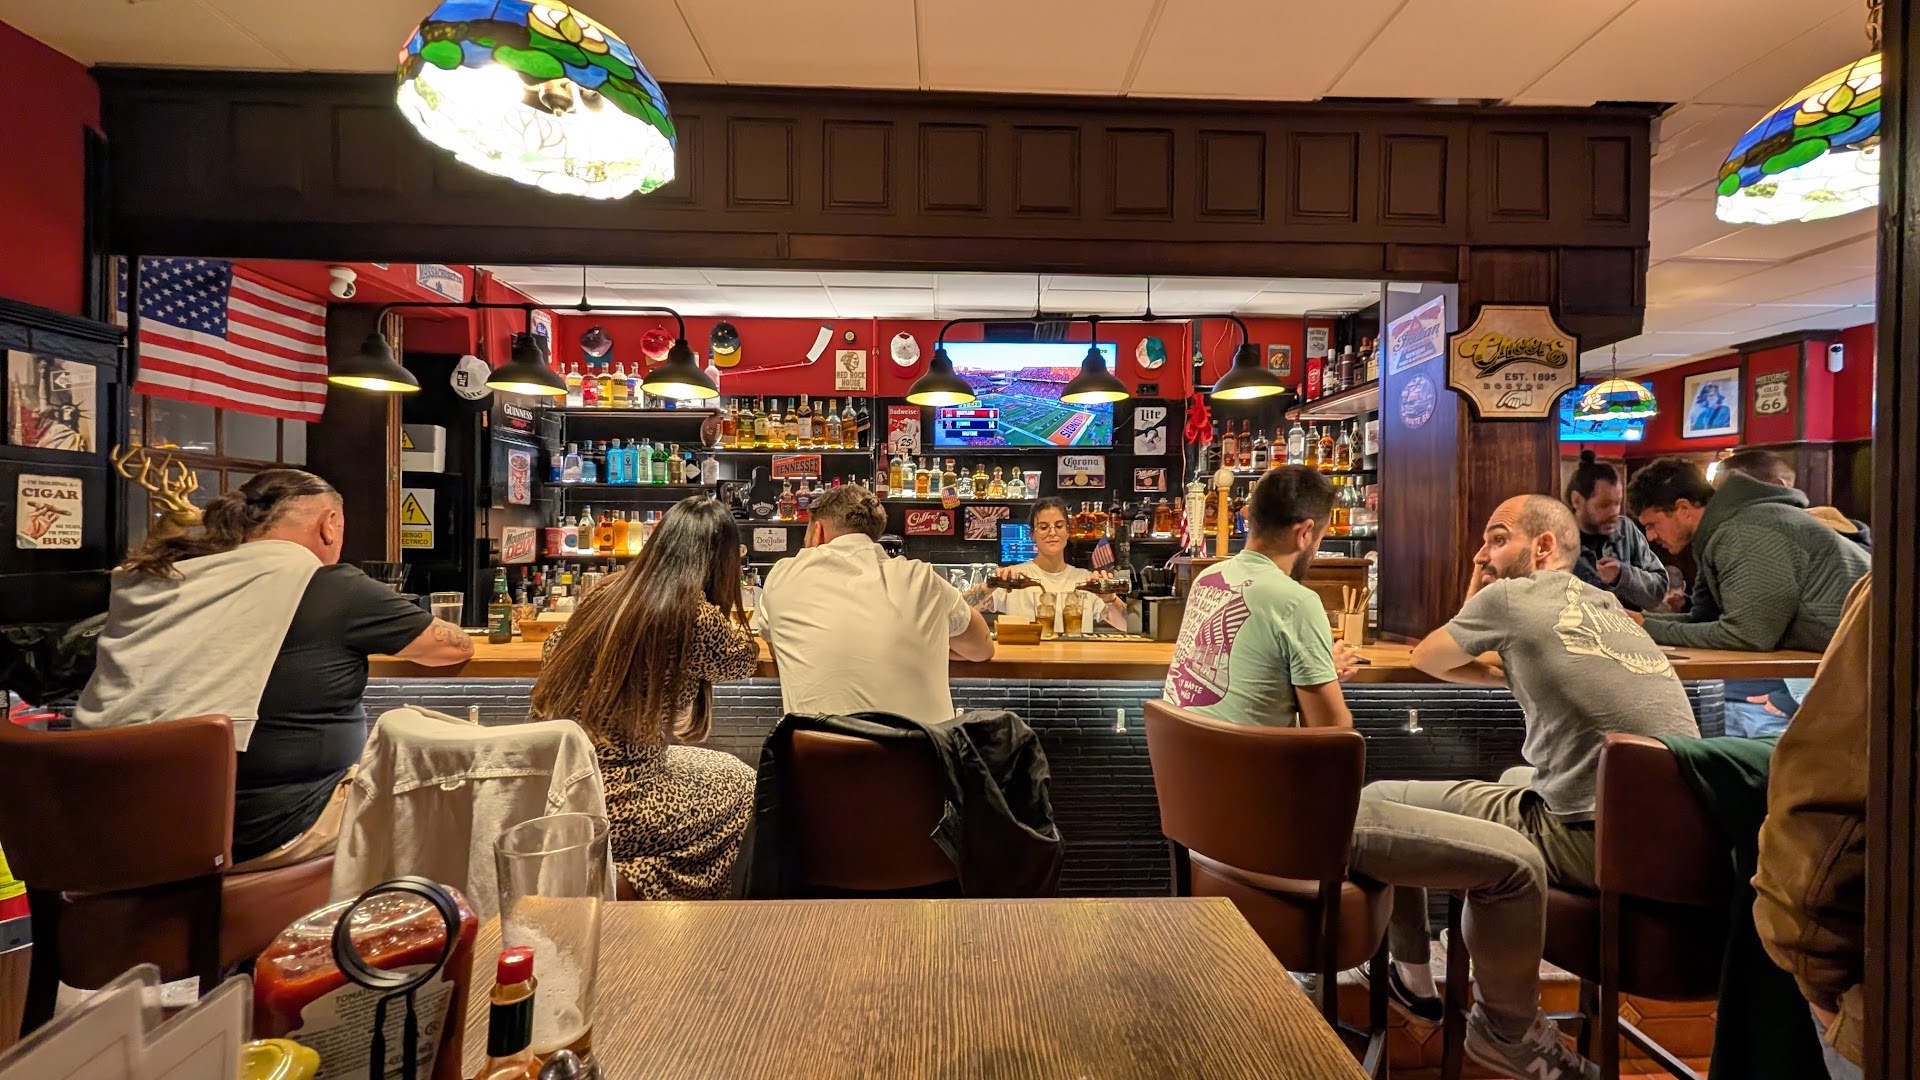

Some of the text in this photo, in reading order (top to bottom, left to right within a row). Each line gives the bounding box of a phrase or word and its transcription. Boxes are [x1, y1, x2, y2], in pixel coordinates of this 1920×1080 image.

[1393, 323, 1440, 352] Indian
[1459, 332, 1568, 370] Cheers
[841, 379, 861, 387] HOUSE
[1504, 373, 1557, 381] EST. 1895
[1761, 399, 1781, 410] 66
[504, 403, 533, 420] GUINNESS
[1141, 409, 1161, 421] Lite
[775, 459, 818, 474] TENNESSEE
[1063, 457, 1099, 468] Corona
[1136, 470, 1160, 479] Miller
[21, 488, 79, 500] CIGAR
[907, 511, 940, 527] Coffee!
[505, 531, 534, 546] Mountain
[506, 537, 534, 559] DEW
